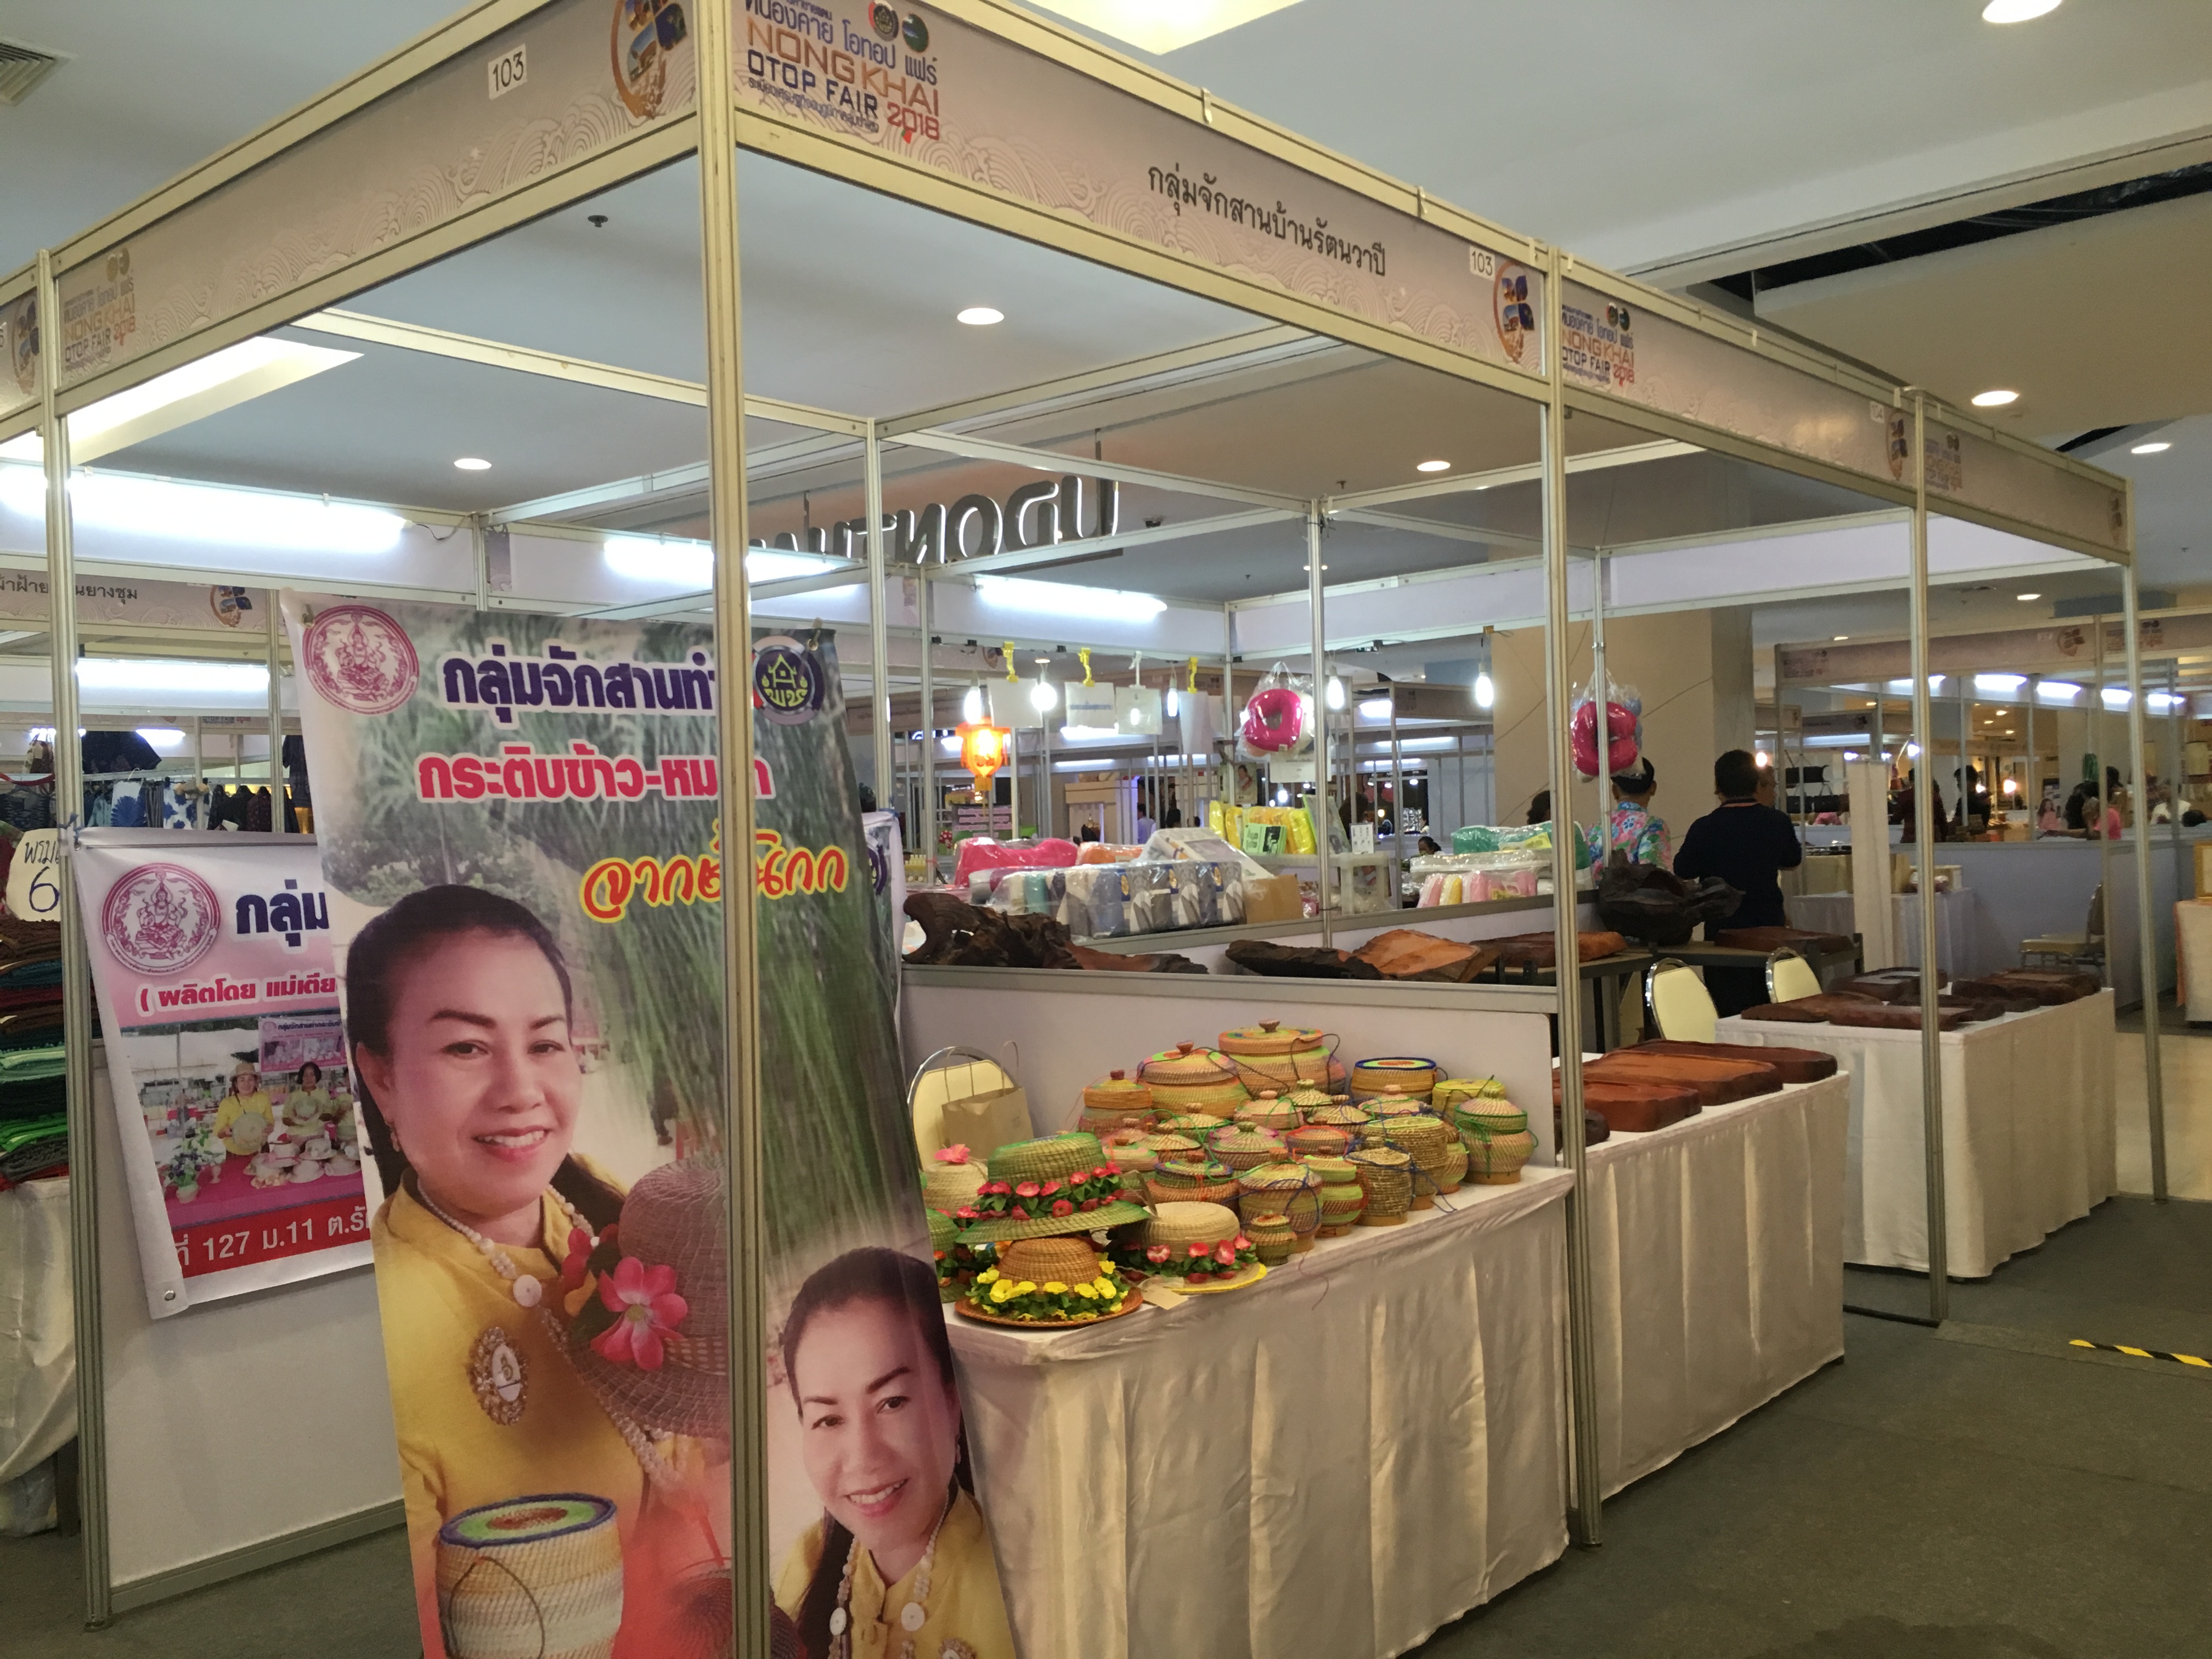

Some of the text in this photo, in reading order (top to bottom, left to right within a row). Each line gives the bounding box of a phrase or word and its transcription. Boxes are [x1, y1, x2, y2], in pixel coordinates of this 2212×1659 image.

[746, 15, 939, 117] NONG KHAI
[842, 19, 896, 69] โอทอป
[493, 50, 524, 92] 103
[747, 49, 940, 141] OTOP FAIR 2018
[1148, 162, 1386, 276] กลุ่มจักสานบ้านรัตนวาปี
[1472, 251, 1493, 276] 103
[64, 310, 103, 345] NONG
[105, 292, 135, 328] KHAI
[65, 338, 89, 363] OTOP
[92, 327, 111, 351] FAIR
[1562, 329, 1634, 369] NONG KHAI
[1590, 356, 1611, 373] FAIR
[418, 743, 772, 799] กระติบข้าว-หมก
[29, 866, 59, 913] 6
[235, 878, 330, 947] กลุ่ม
[158, 978, 256, 1007] ผลิตโดย
[202, 1231, 250, 1261] 127
[262, 1217, 313, 1250] ม.11
[328, 1205, 370, 1237] ต.รั
